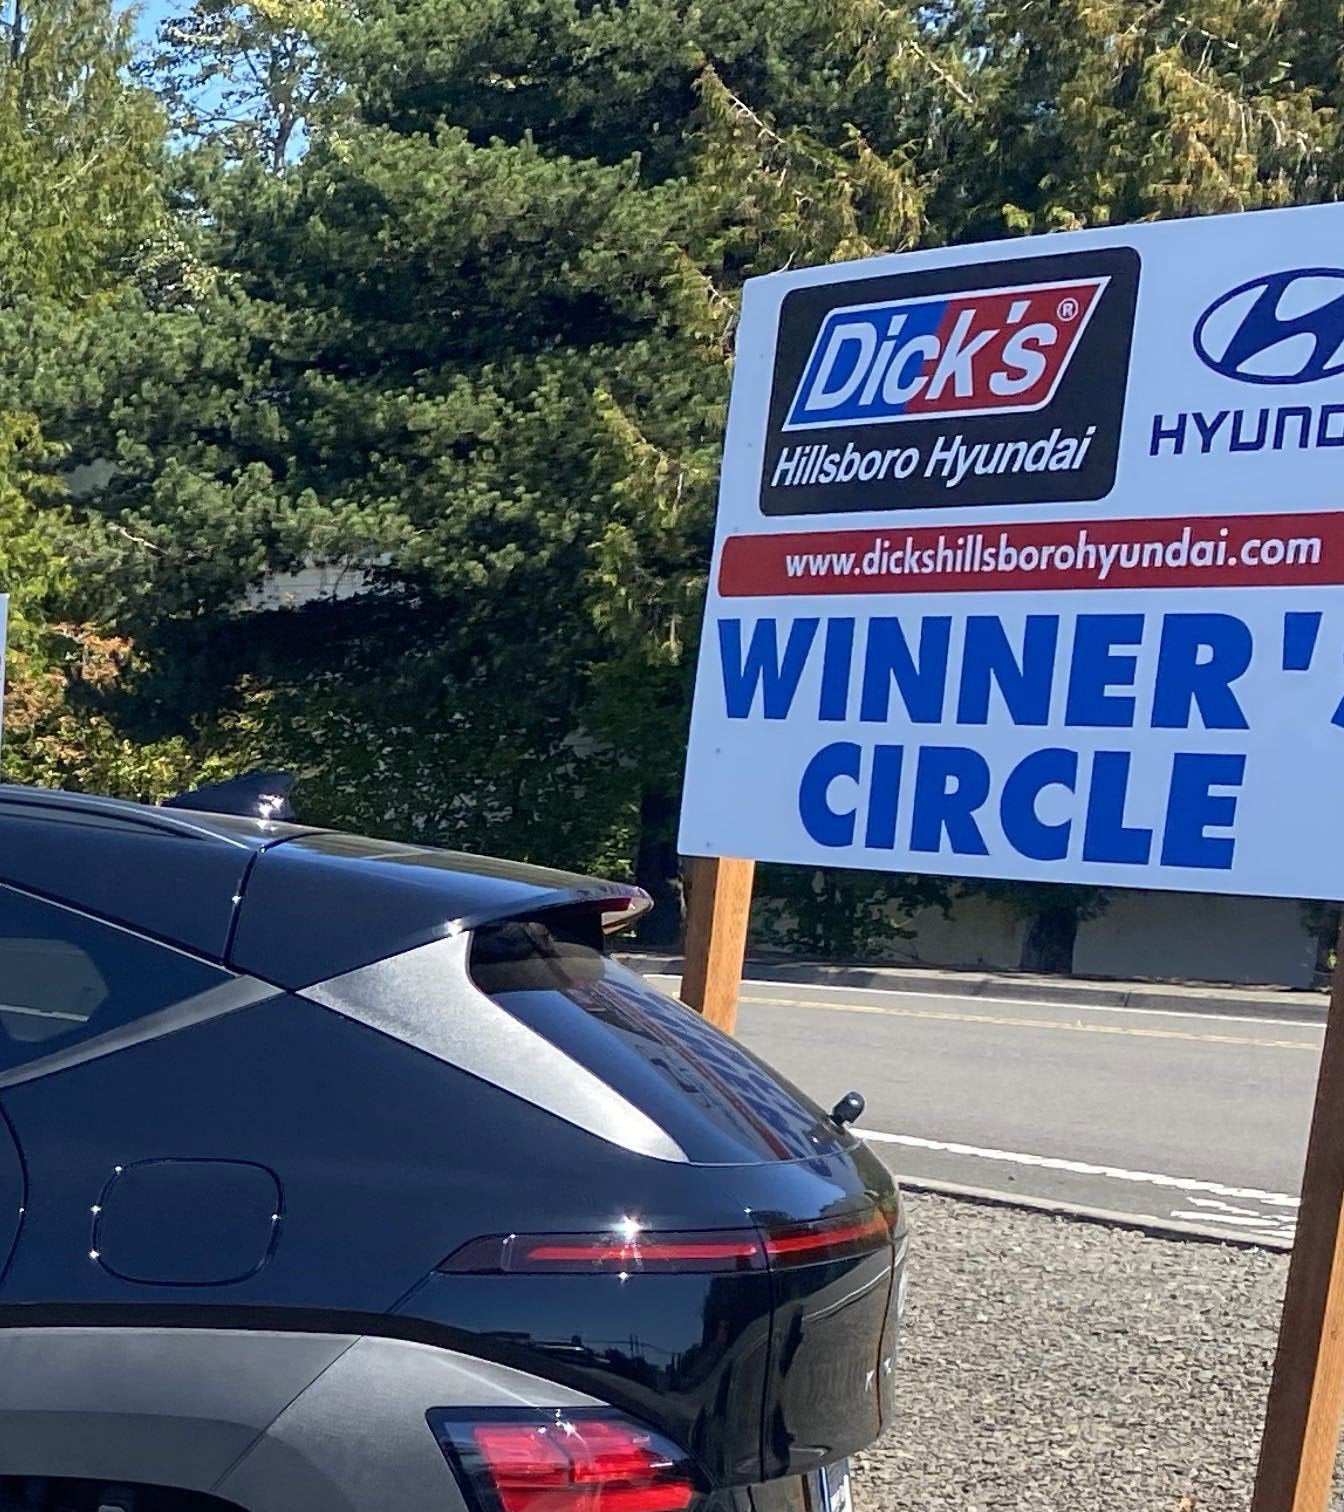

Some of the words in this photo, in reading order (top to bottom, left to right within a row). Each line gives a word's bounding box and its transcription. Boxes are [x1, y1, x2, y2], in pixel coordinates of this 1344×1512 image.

[770, 442, 920, 488] Hillsboro
[923, 426, 1097, 488] Hyundai
[785, 527, 1321, 580] www.dickshillsborohyundai.com
[717, 611, 1344, 730] WINNER'
[799, 741, 1247, 869] CIRCLE
